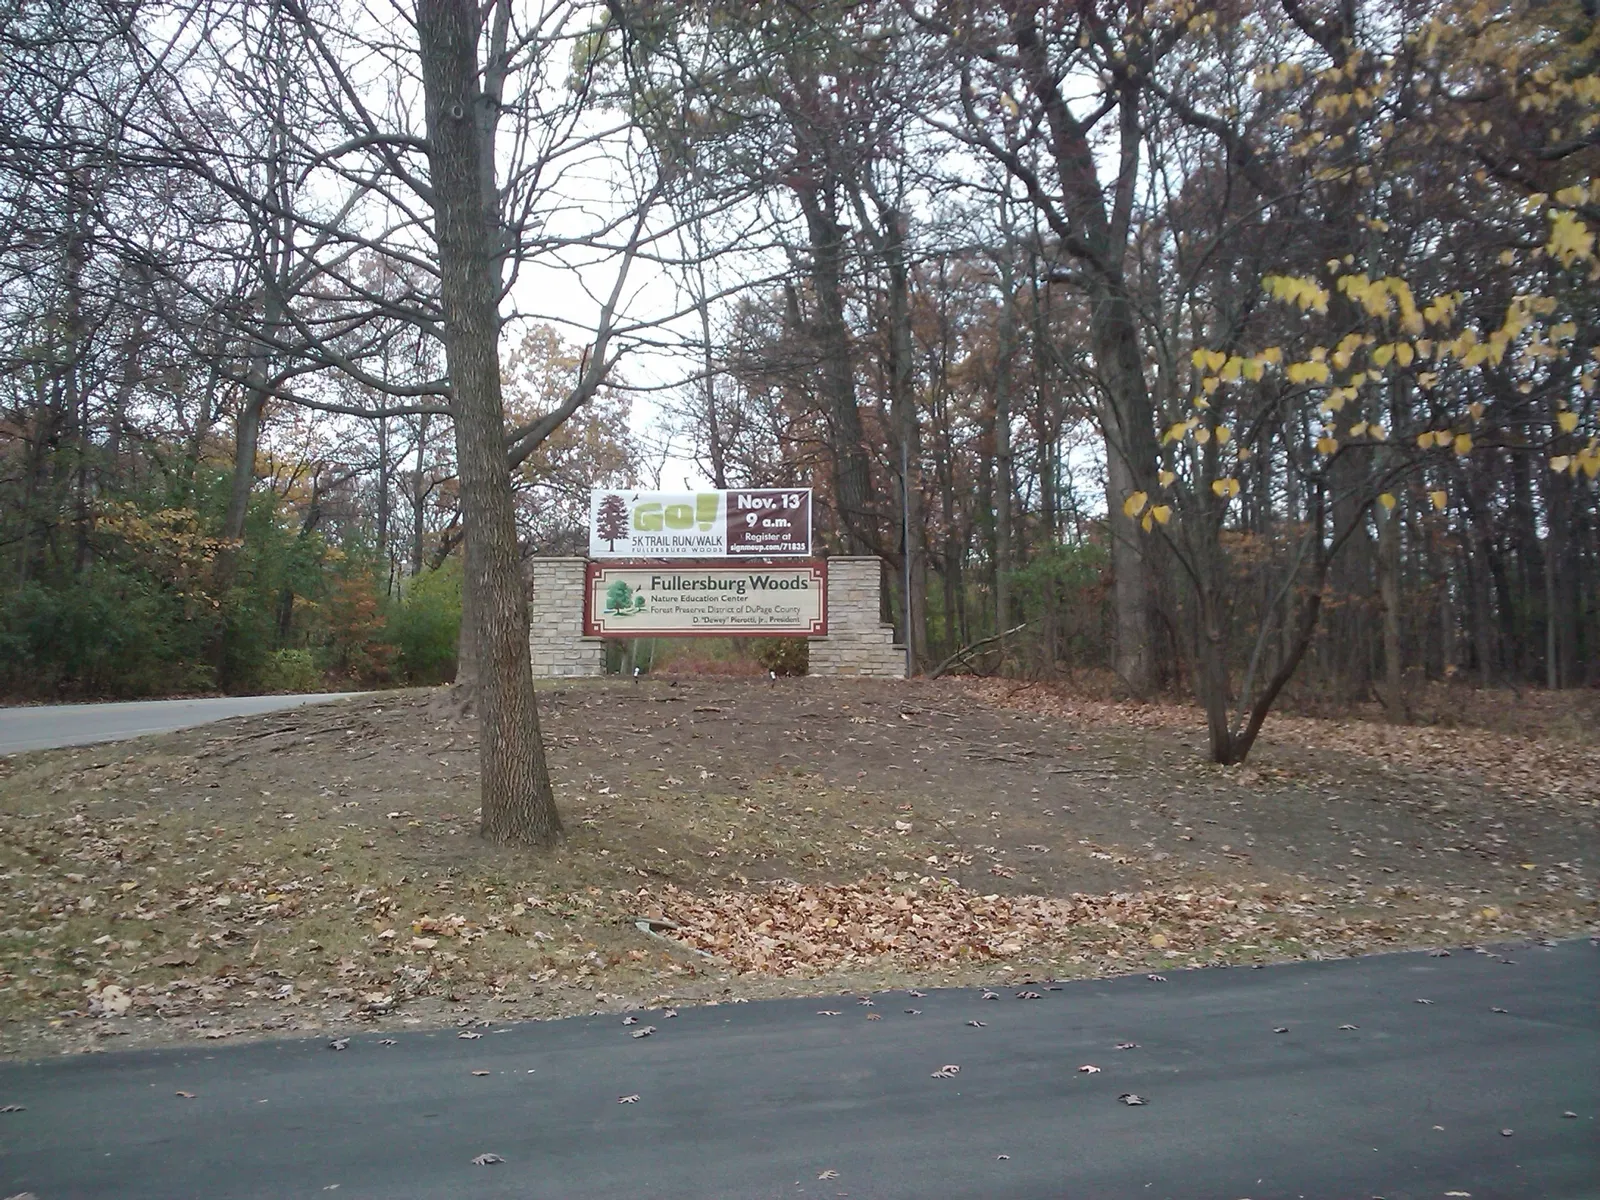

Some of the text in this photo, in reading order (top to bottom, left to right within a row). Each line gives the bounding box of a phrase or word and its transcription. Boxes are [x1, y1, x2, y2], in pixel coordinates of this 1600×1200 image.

[738, 494, 800, 509] Nov. 13
[633, 493, 720, 532] GO!
[746, 512, 791, 528] 9 a.m.
[632, 536, 722, 546] 5K TRAIL RUN/WALK
[745, 532, 791, 542] Register at
[730, 543, 806, 552] signmeup.com/71835
[651, 575, 808, 595] Fullersburg Woods
[651, 605, 800, 615] Forest Preserve District of DuPage County
